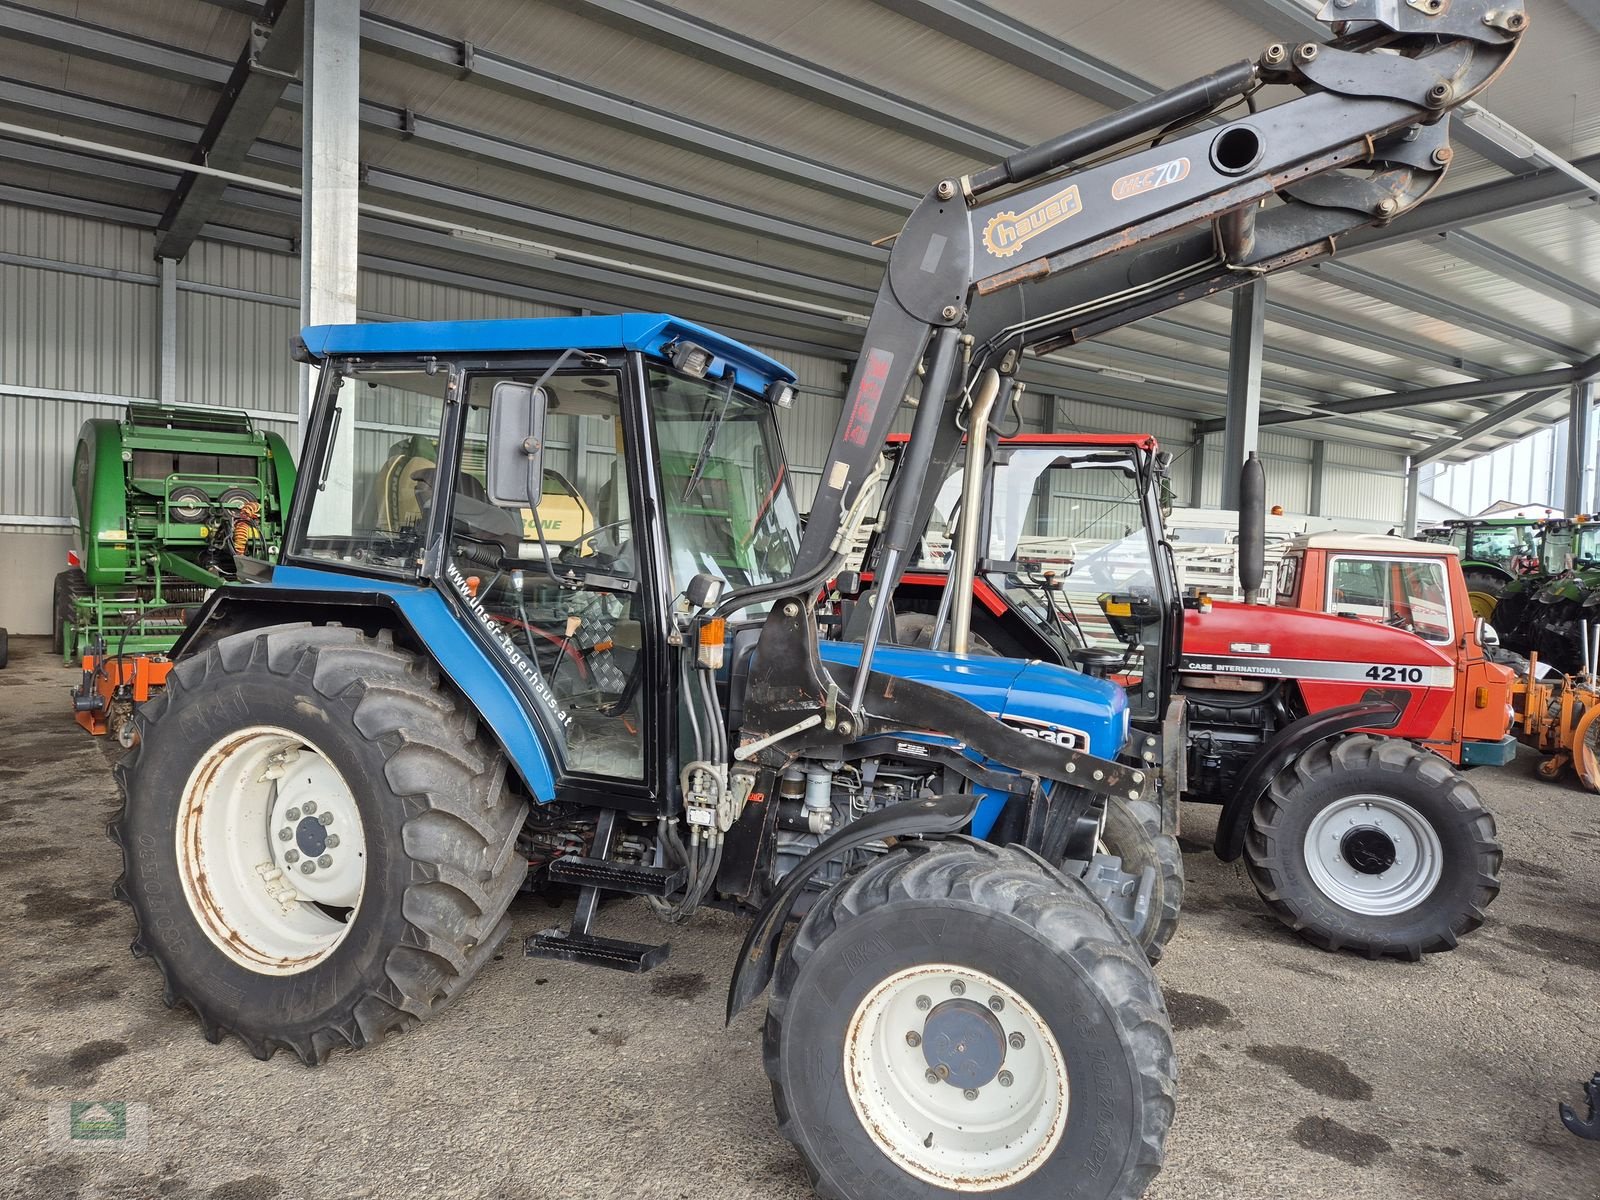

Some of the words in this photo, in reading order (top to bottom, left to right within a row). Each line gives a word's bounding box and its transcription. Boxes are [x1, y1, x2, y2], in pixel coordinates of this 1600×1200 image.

[996, 192, 1076, 247] hauer
[447, 563, 573, 727] www.unser-lagerhaus.at
[1188, 662, 1213, 671] CASE
[1216, 664, 1282, 675] INTERNATIONAL
[1365, 665, 1423, 683] 4210
[1009, 726, 1076, 749] 30
